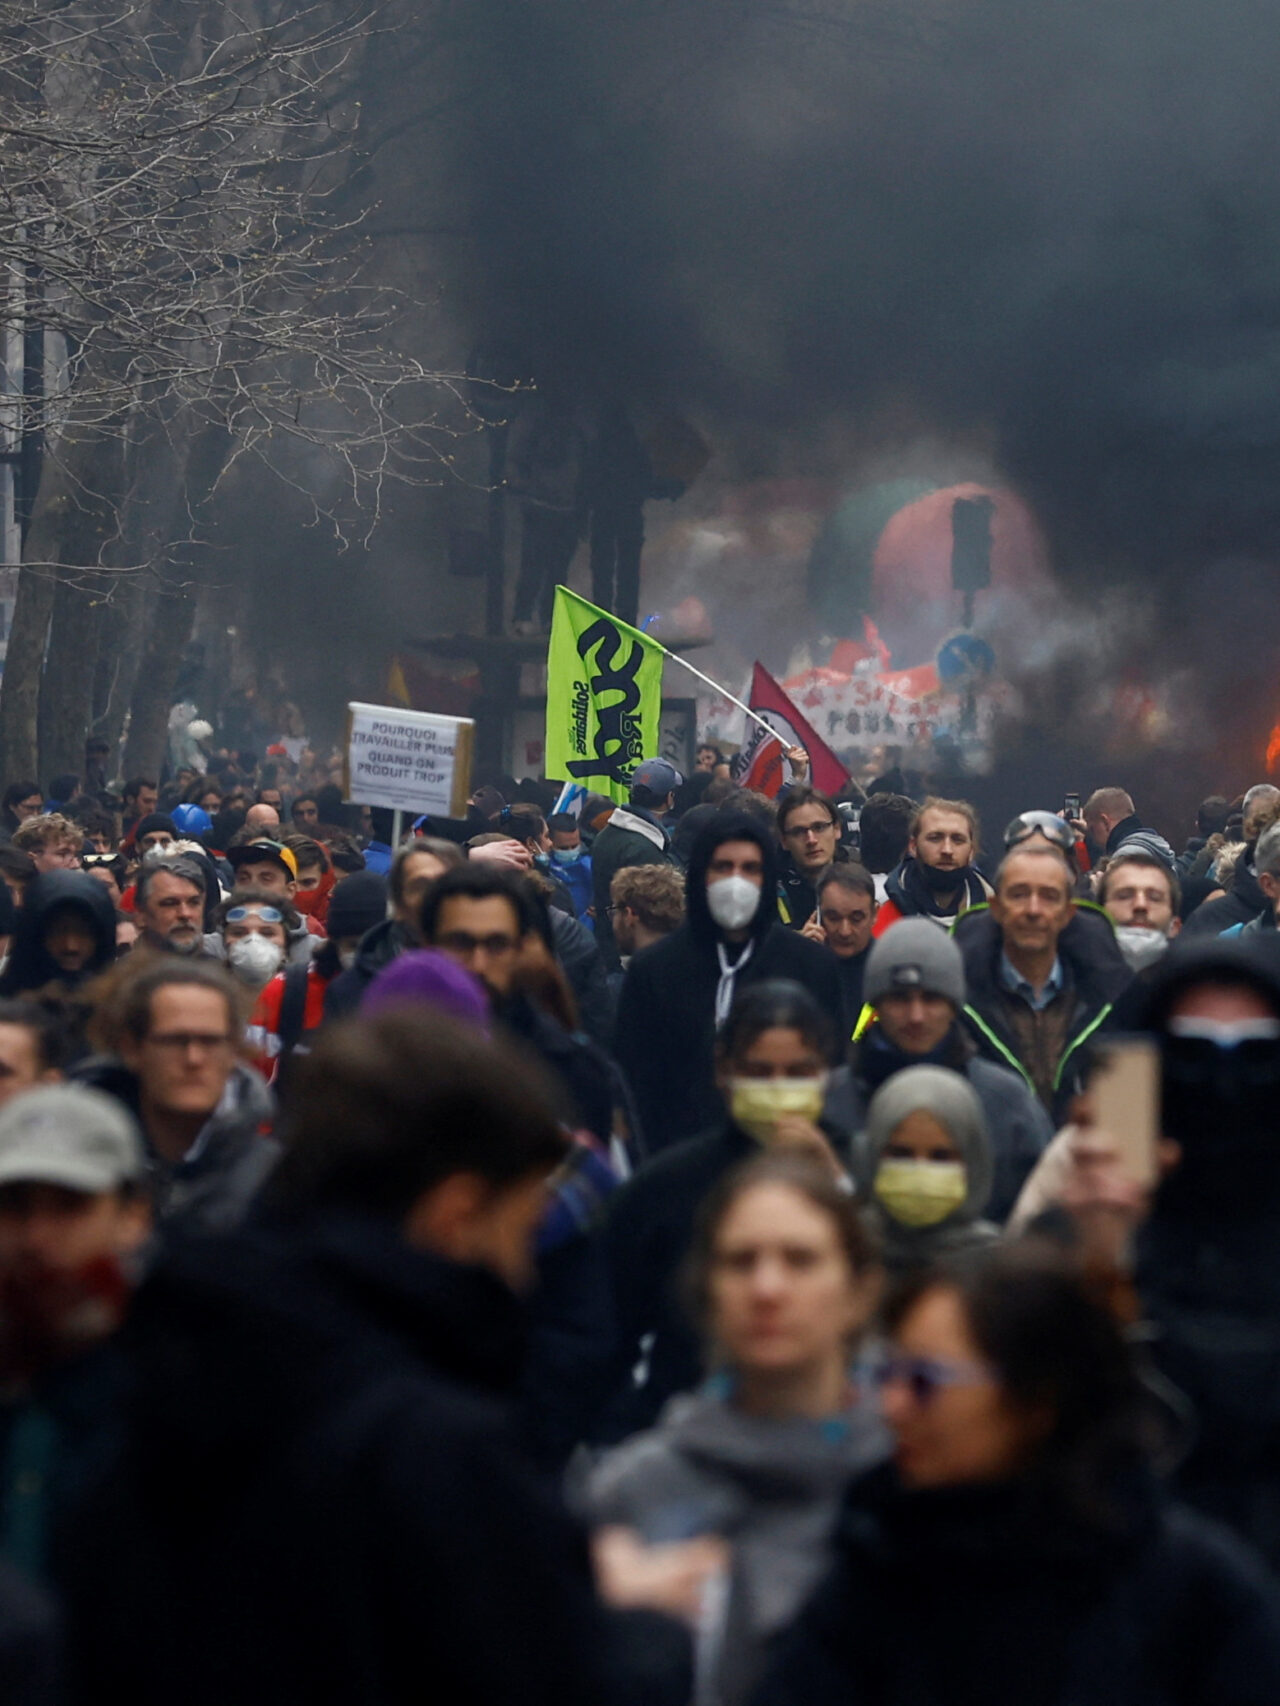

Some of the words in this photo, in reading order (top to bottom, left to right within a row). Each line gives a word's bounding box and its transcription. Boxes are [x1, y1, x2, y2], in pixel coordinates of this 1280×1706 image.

[371, 721, 437, 741] POURQUOI
[353, 732, 422, 753] TRAVAILLER
[424, 742, 455, 757] PLUS
[367, 750, 413, 767] QUAND
[416, 757, 436, 770] ON
[356, 762, 412, 779] PRODUIT
[413, 770, 446, 785] TROP
